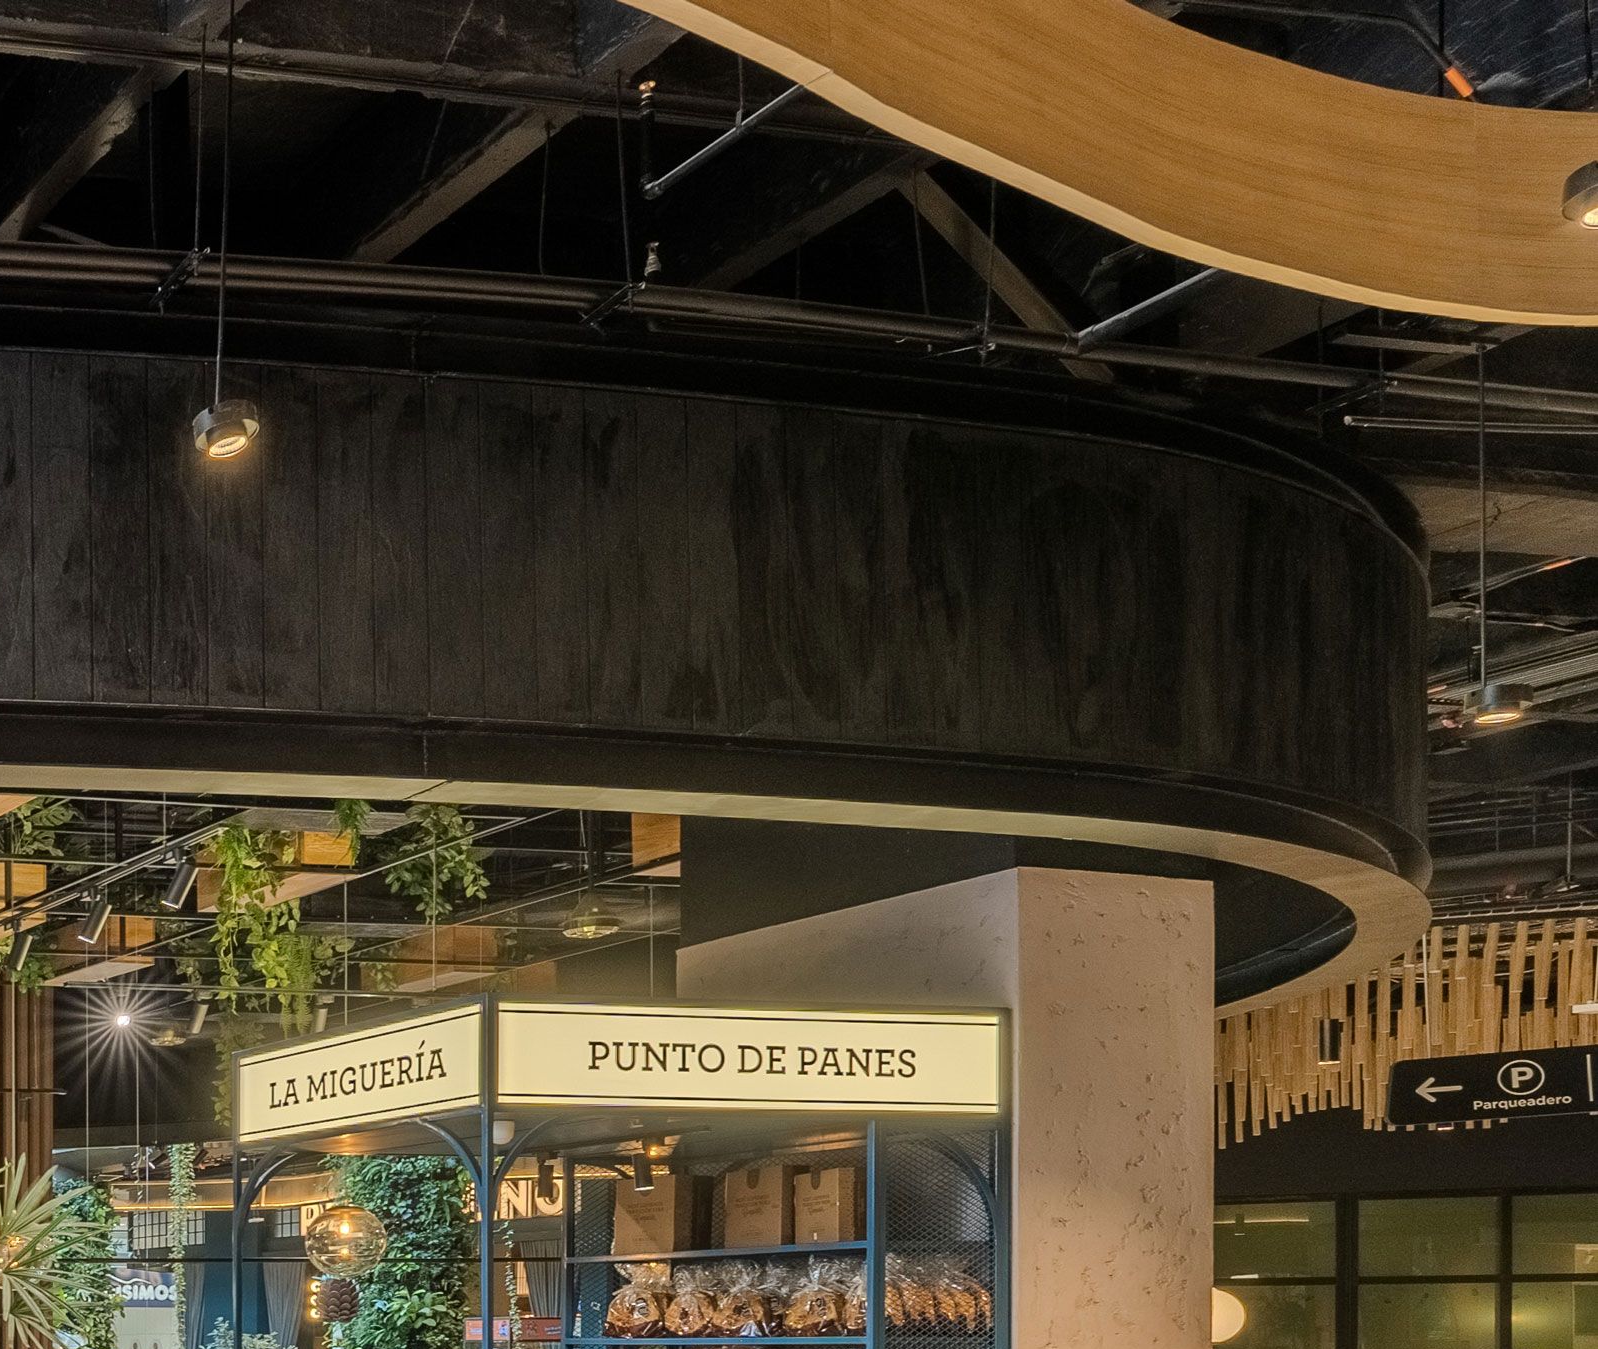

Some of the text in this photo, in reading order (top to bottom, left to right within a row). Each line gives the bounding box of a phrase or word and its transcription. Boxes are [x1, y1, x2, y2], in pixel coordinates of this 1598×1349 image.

[268, 1040, 447, 1110] LA MIGUERÍA
[587, 1041, 918, 1080] PUNTO DE PANES
[1473, 1094, 1573, 1111] Parqueadero
